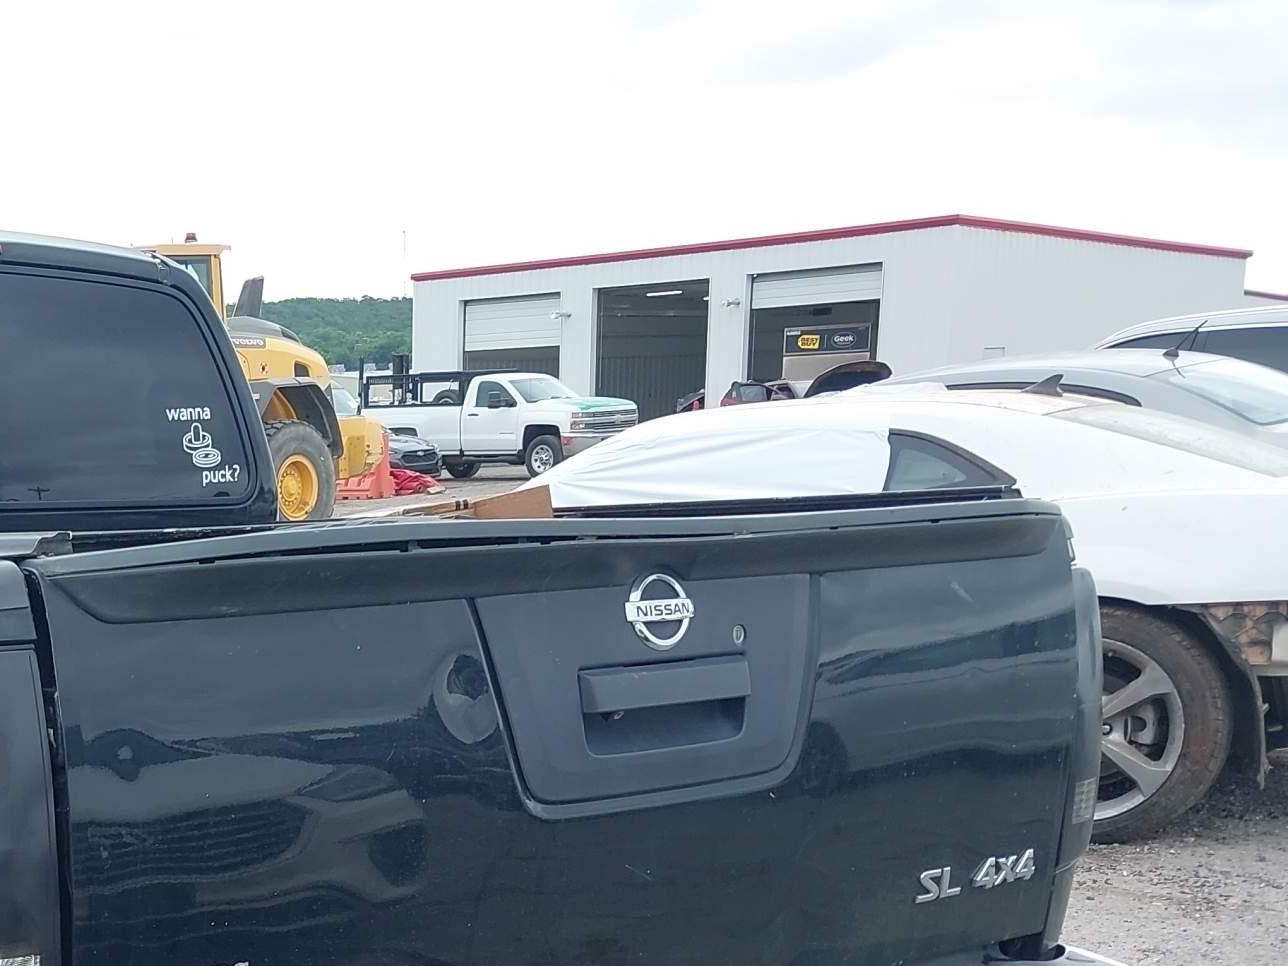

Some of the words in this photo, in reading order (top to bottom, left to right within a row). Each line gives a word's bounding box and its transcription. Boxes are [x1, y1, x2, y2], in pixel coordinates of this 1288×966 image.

[165, 406, 211, 421] wanna
[202, 464, 240, 487] puck?
[636, 602, 690, 617] NISSAN
[915, 866, 961, 903] SL
